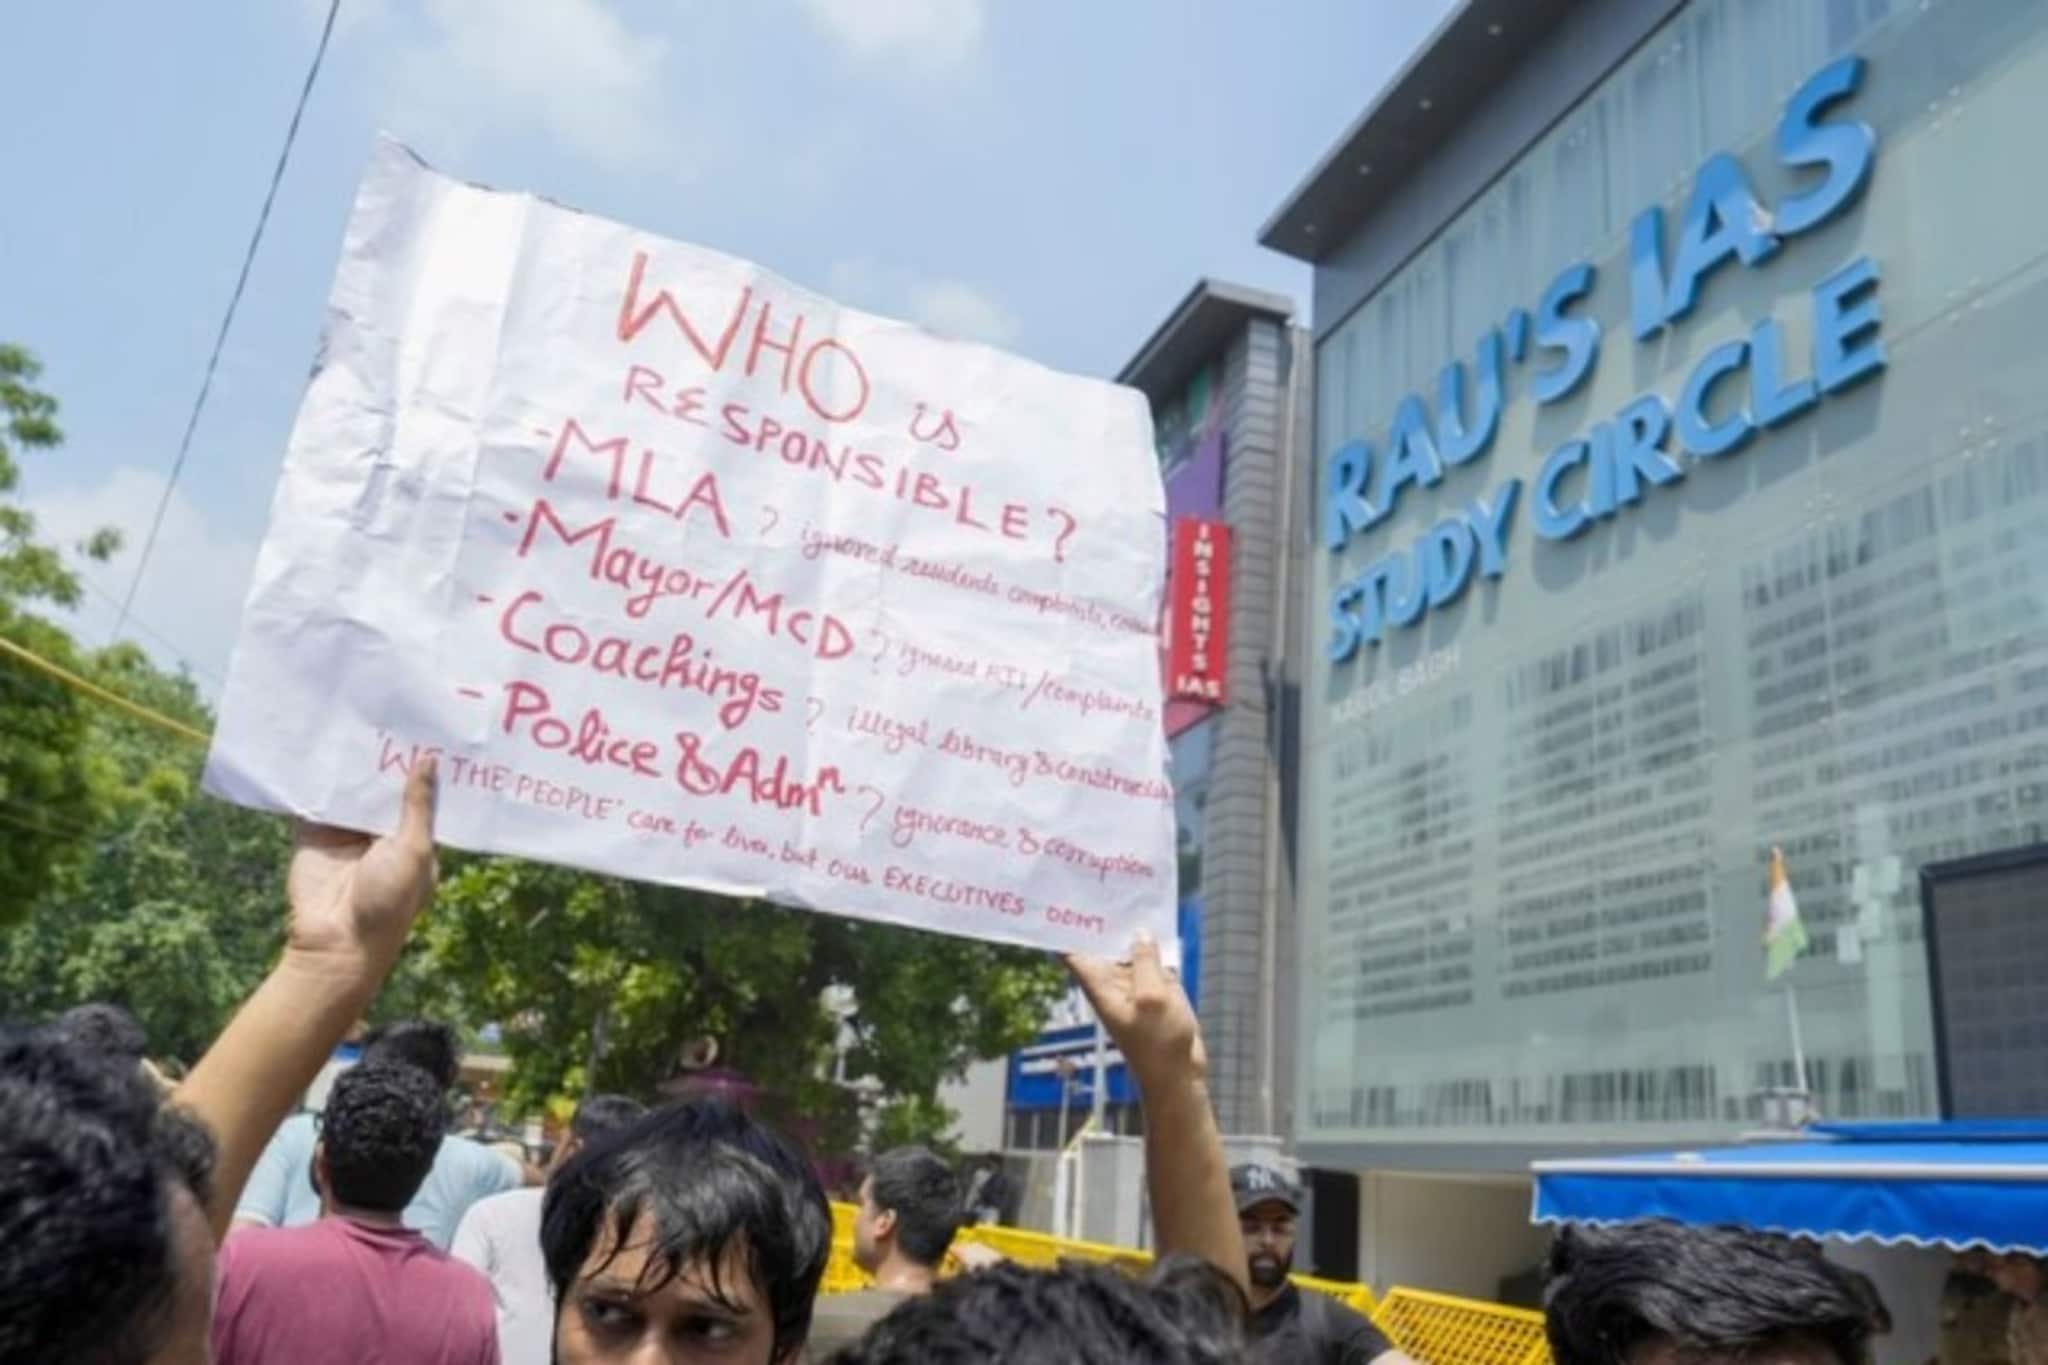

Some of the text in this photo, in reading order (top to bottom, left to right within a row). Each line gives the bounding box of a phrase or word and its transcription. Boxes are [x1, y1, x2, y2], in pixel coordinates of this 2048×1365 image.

[615, 252, 966, 452] WHO is
[1324, 53, 1879, 554] RAU'S IAS
[624, 365, 1078, 564] RESPONSIBLE?
[1326, 256, 1888, 664] STUDY CIRCLE
[1177, 675, 1221, 696] IAS
[1192, 523, 1215, 672] INSIGHTS
[503, 681, 662, 779] Police
[451, 756, 512, 792] THE
[780, 840, 817, 868] but
[883, 864, 1026, 917] EXECUTIVES
